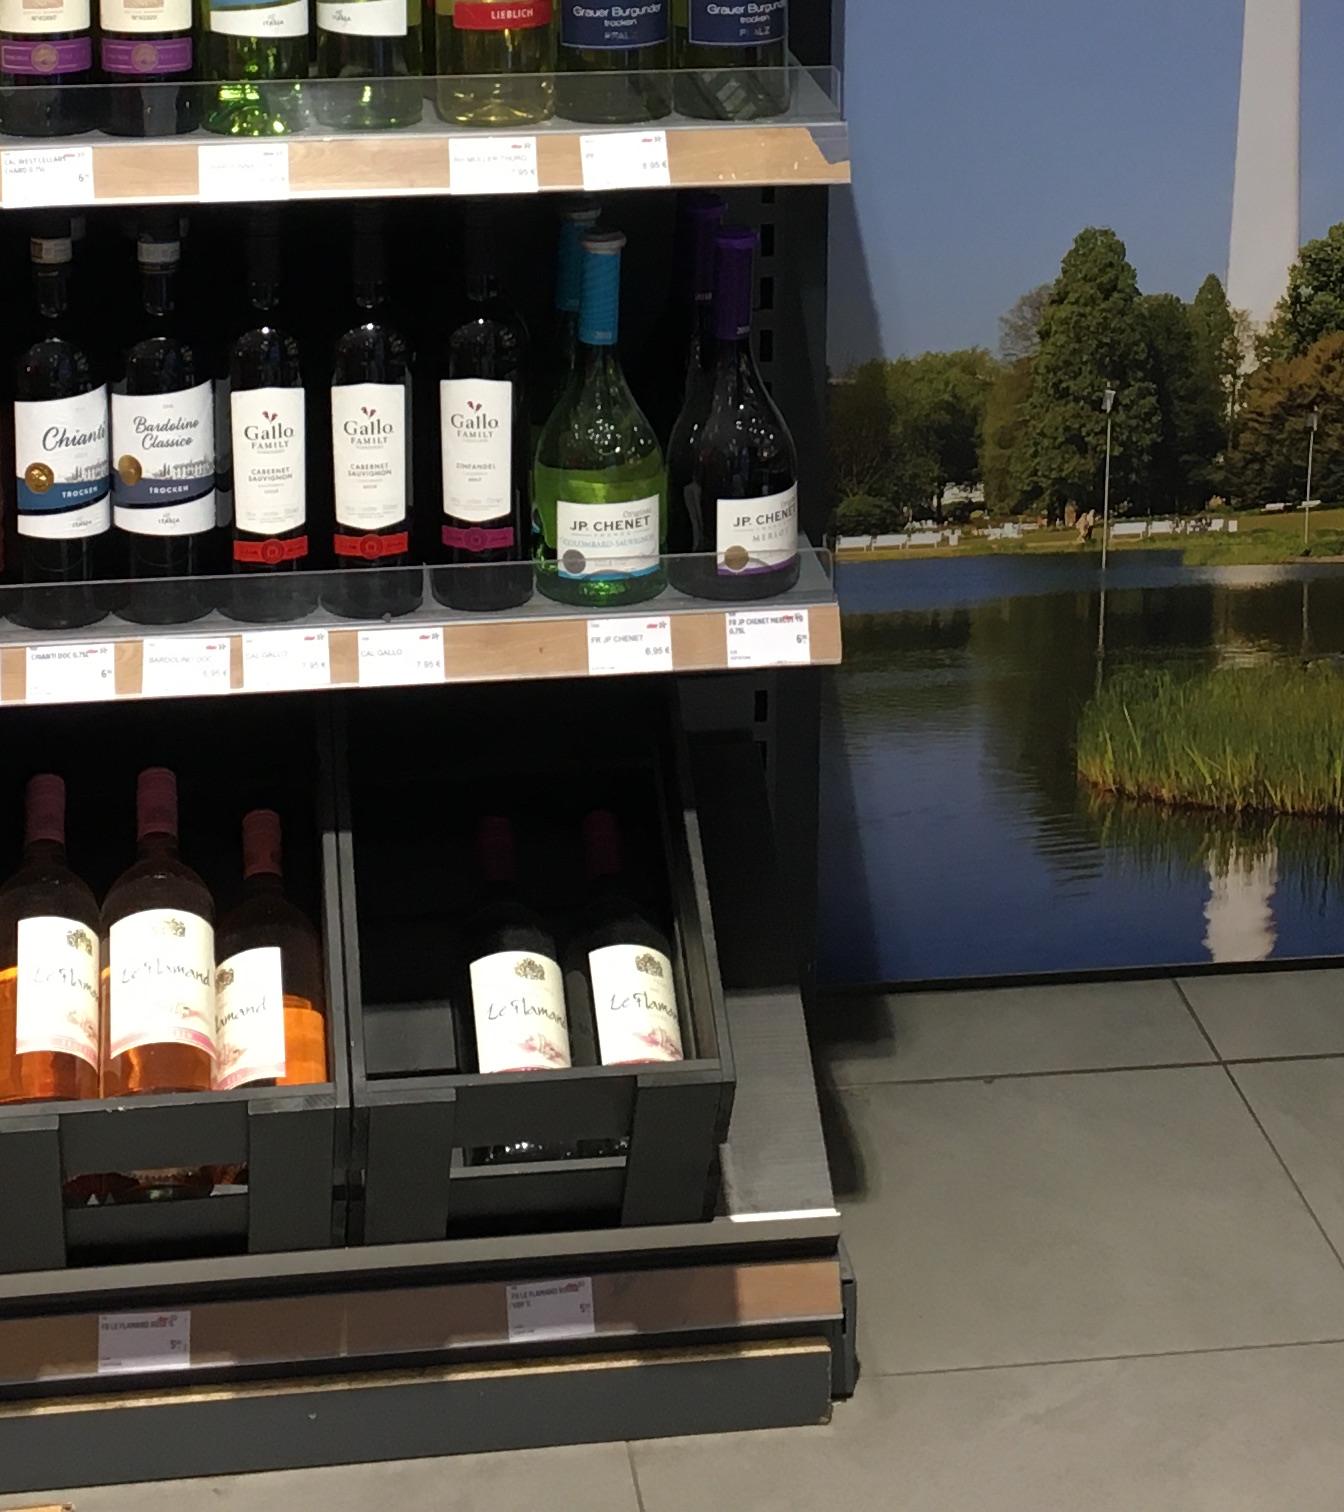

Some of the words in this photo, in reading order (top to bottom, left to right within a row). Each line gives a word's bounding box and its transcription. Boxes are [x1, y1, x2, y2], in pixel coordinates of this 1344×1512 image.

[491, 7, 533, 20] LIEBLICH
[133, 416, 200, 435] Bardolino
[451, 412, 499, 429] Gallo
[42, 423, 106, 451] Chianti
[243, 424, 294, 441] Gallo
[344, 421, 394, 437] Gallo
[142, 434, 193, 450] Classico
[251, 441, 290, 451] FAMILY
[248, 474, 293, 482] SAUVIGNON
[251, 467, 290, 475] CABERNET
[149, 485, 189, 494] TROCKEN
[593, 516, 651, 532] CHENET
[615, 634, 644, 642] CHENET
